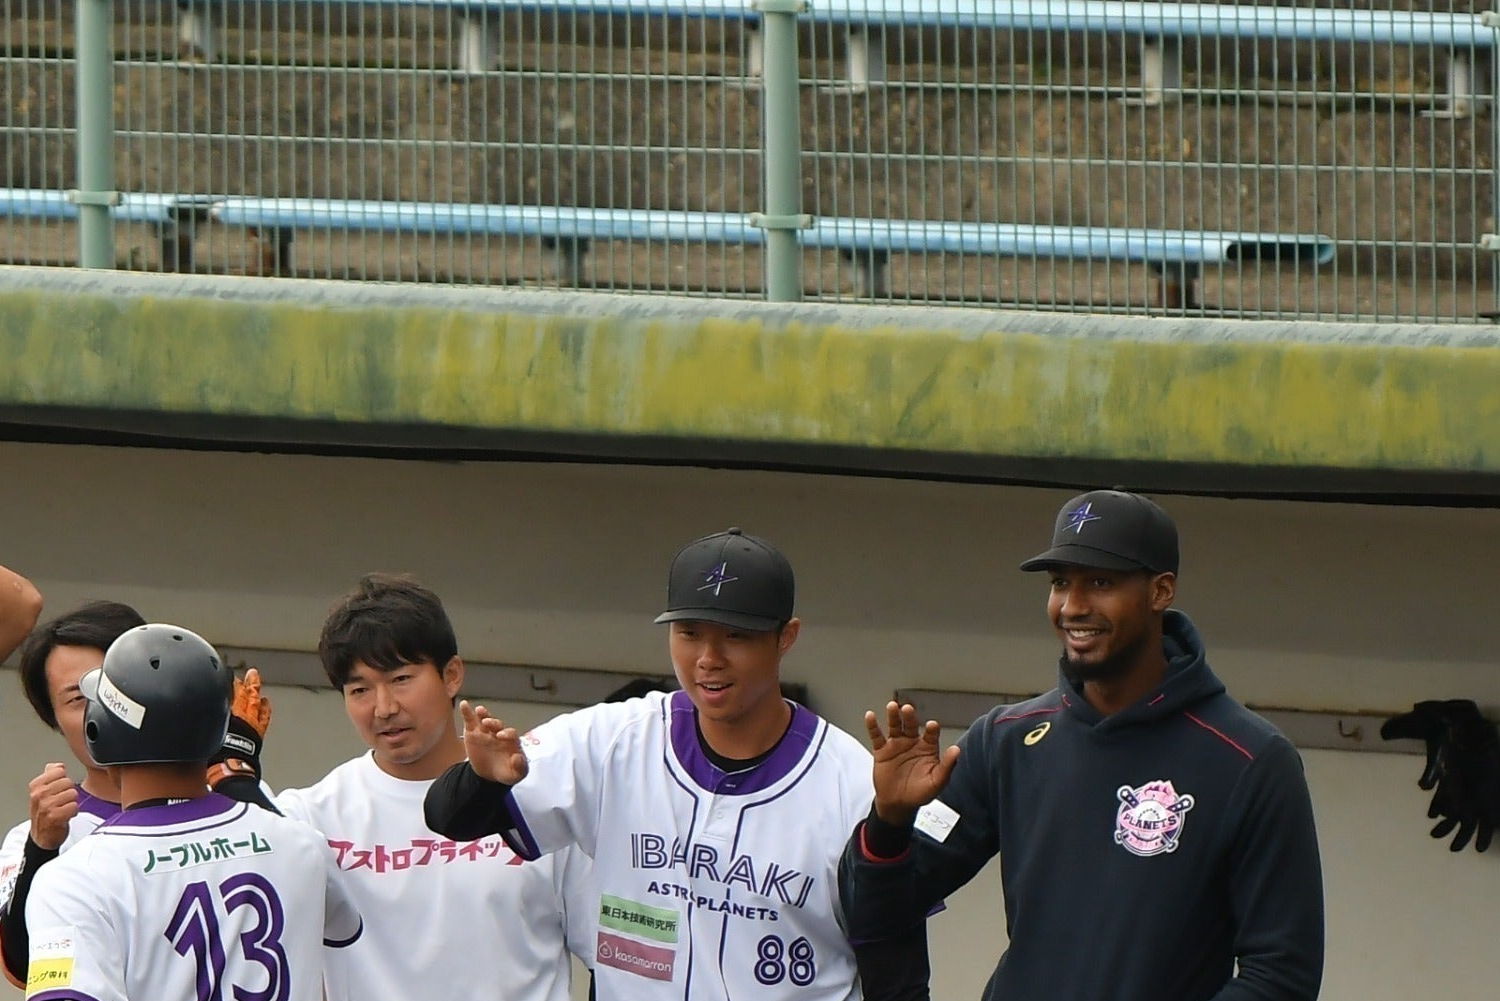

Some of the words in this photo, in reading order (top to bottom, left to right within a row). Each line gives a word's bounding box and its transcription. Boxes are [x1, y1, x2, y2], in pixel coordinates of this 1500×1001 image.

[1122, 813, 1177, 831] PLANETS
[143, 831, 272, 874] ノーブルホーム
[601, 903, 678, 933] 東日本技術研究所
[696, 895, 779, 922] PLANETS
[614, 946, 672, 973] kasamarron
[753, 934, 817, 987] 88
